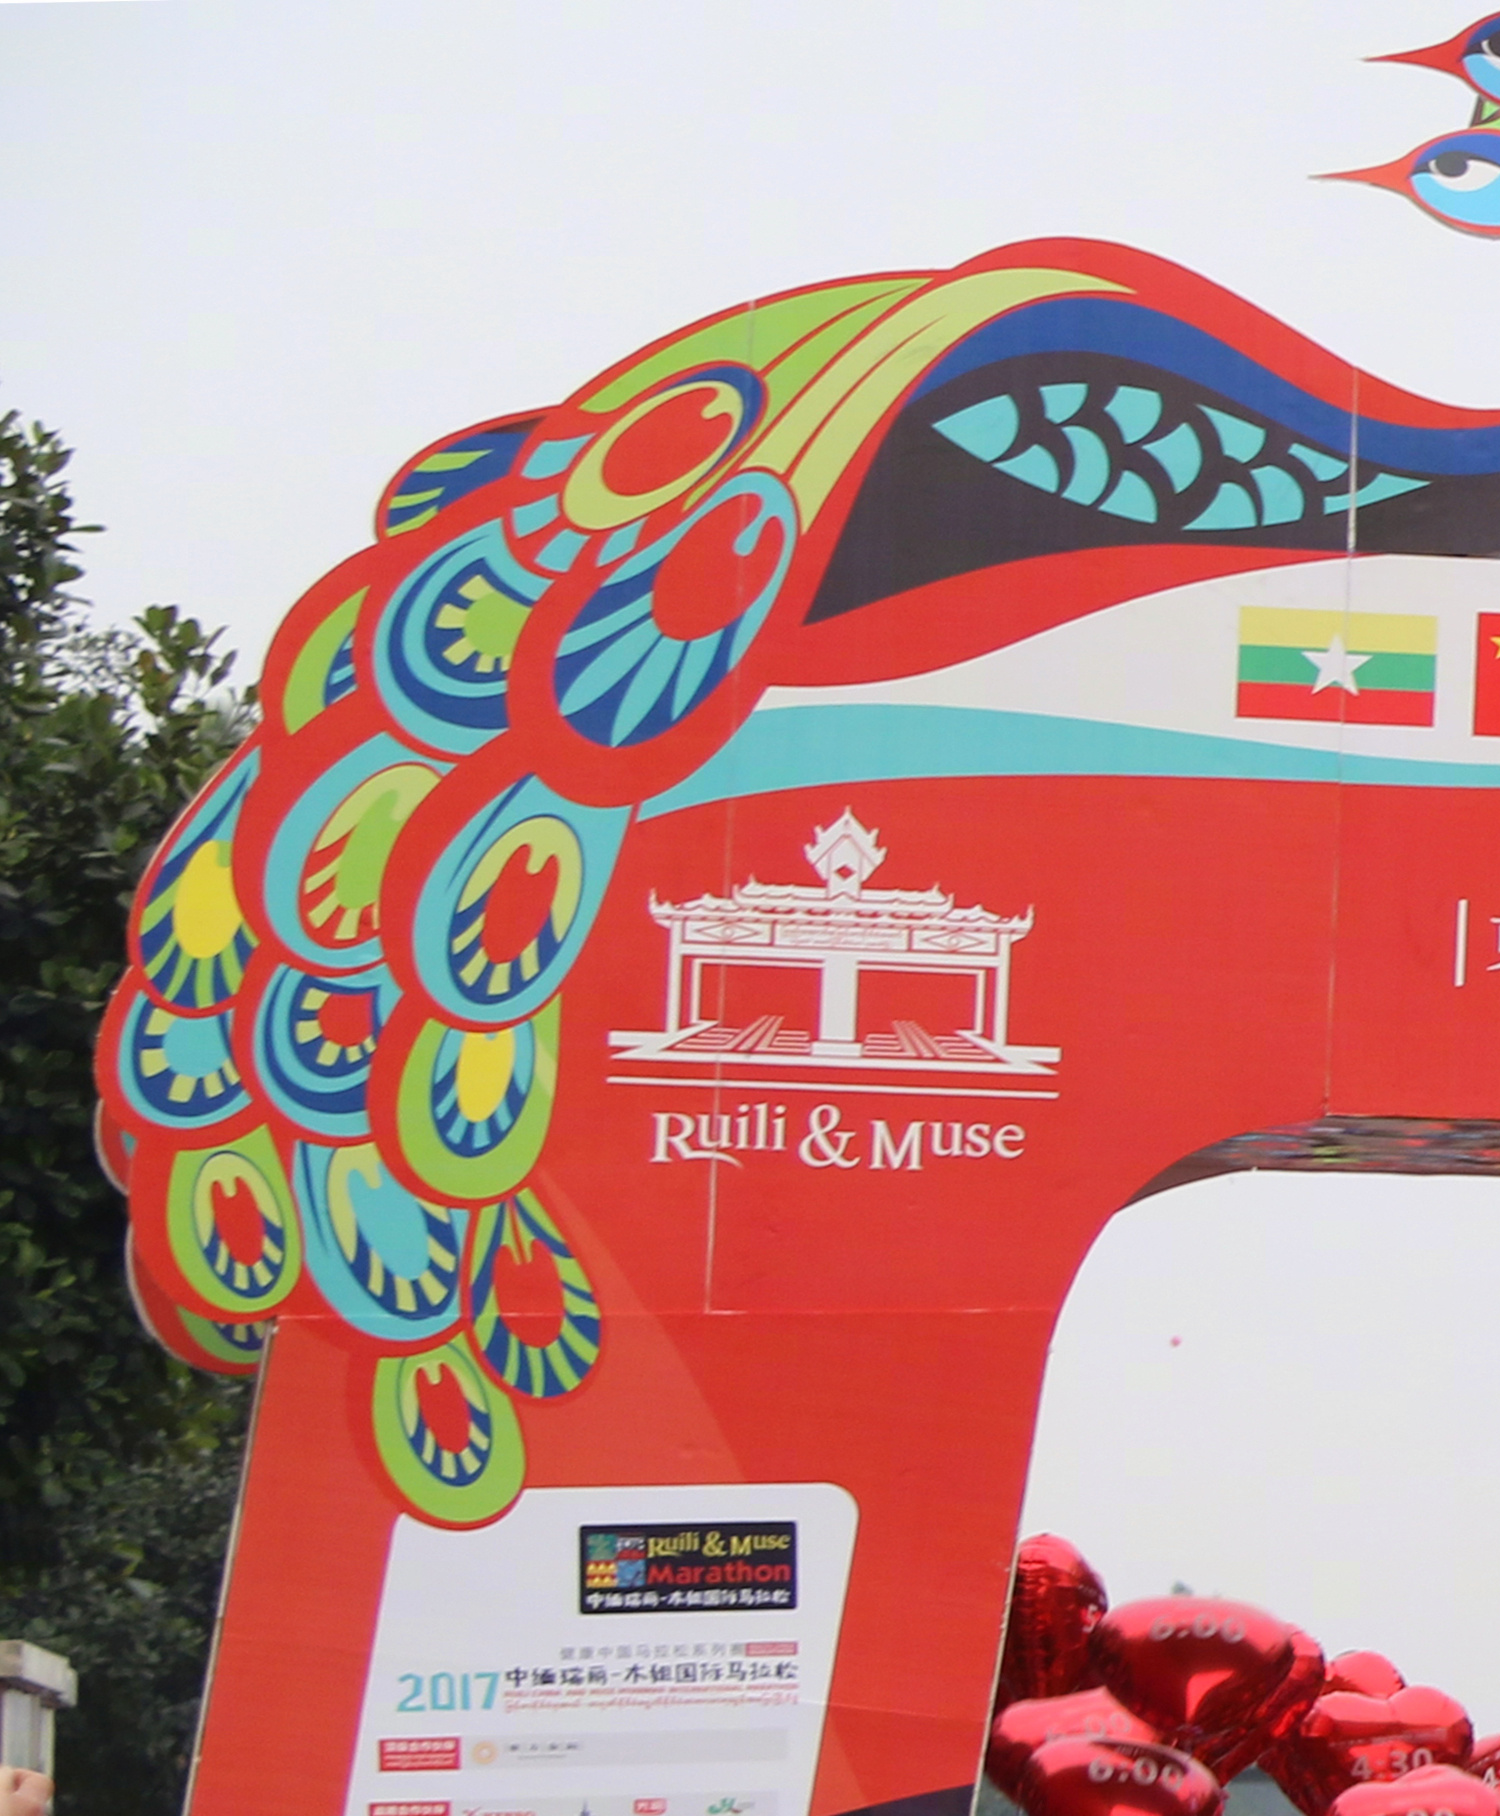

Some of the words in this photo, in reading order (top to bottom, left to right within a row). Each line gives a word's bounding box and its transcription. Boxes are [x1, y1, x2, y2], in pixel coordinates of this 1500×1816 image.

[648, 1102, 788, 1169] Ruili
[798, 1103, 862, 1169] &
[868, 1118, 1026, 1171] Muse
[648, 1531, 700, 1558] Ruili
[702, 1530, 727, 1557] &
[730, 1532, 791, 1557] Muse
[646, 1559, 791, 1586] Marathon
[1148, 1611, 1247, 1644] 6:00
[396, 1670, 502, 1714] 2017
